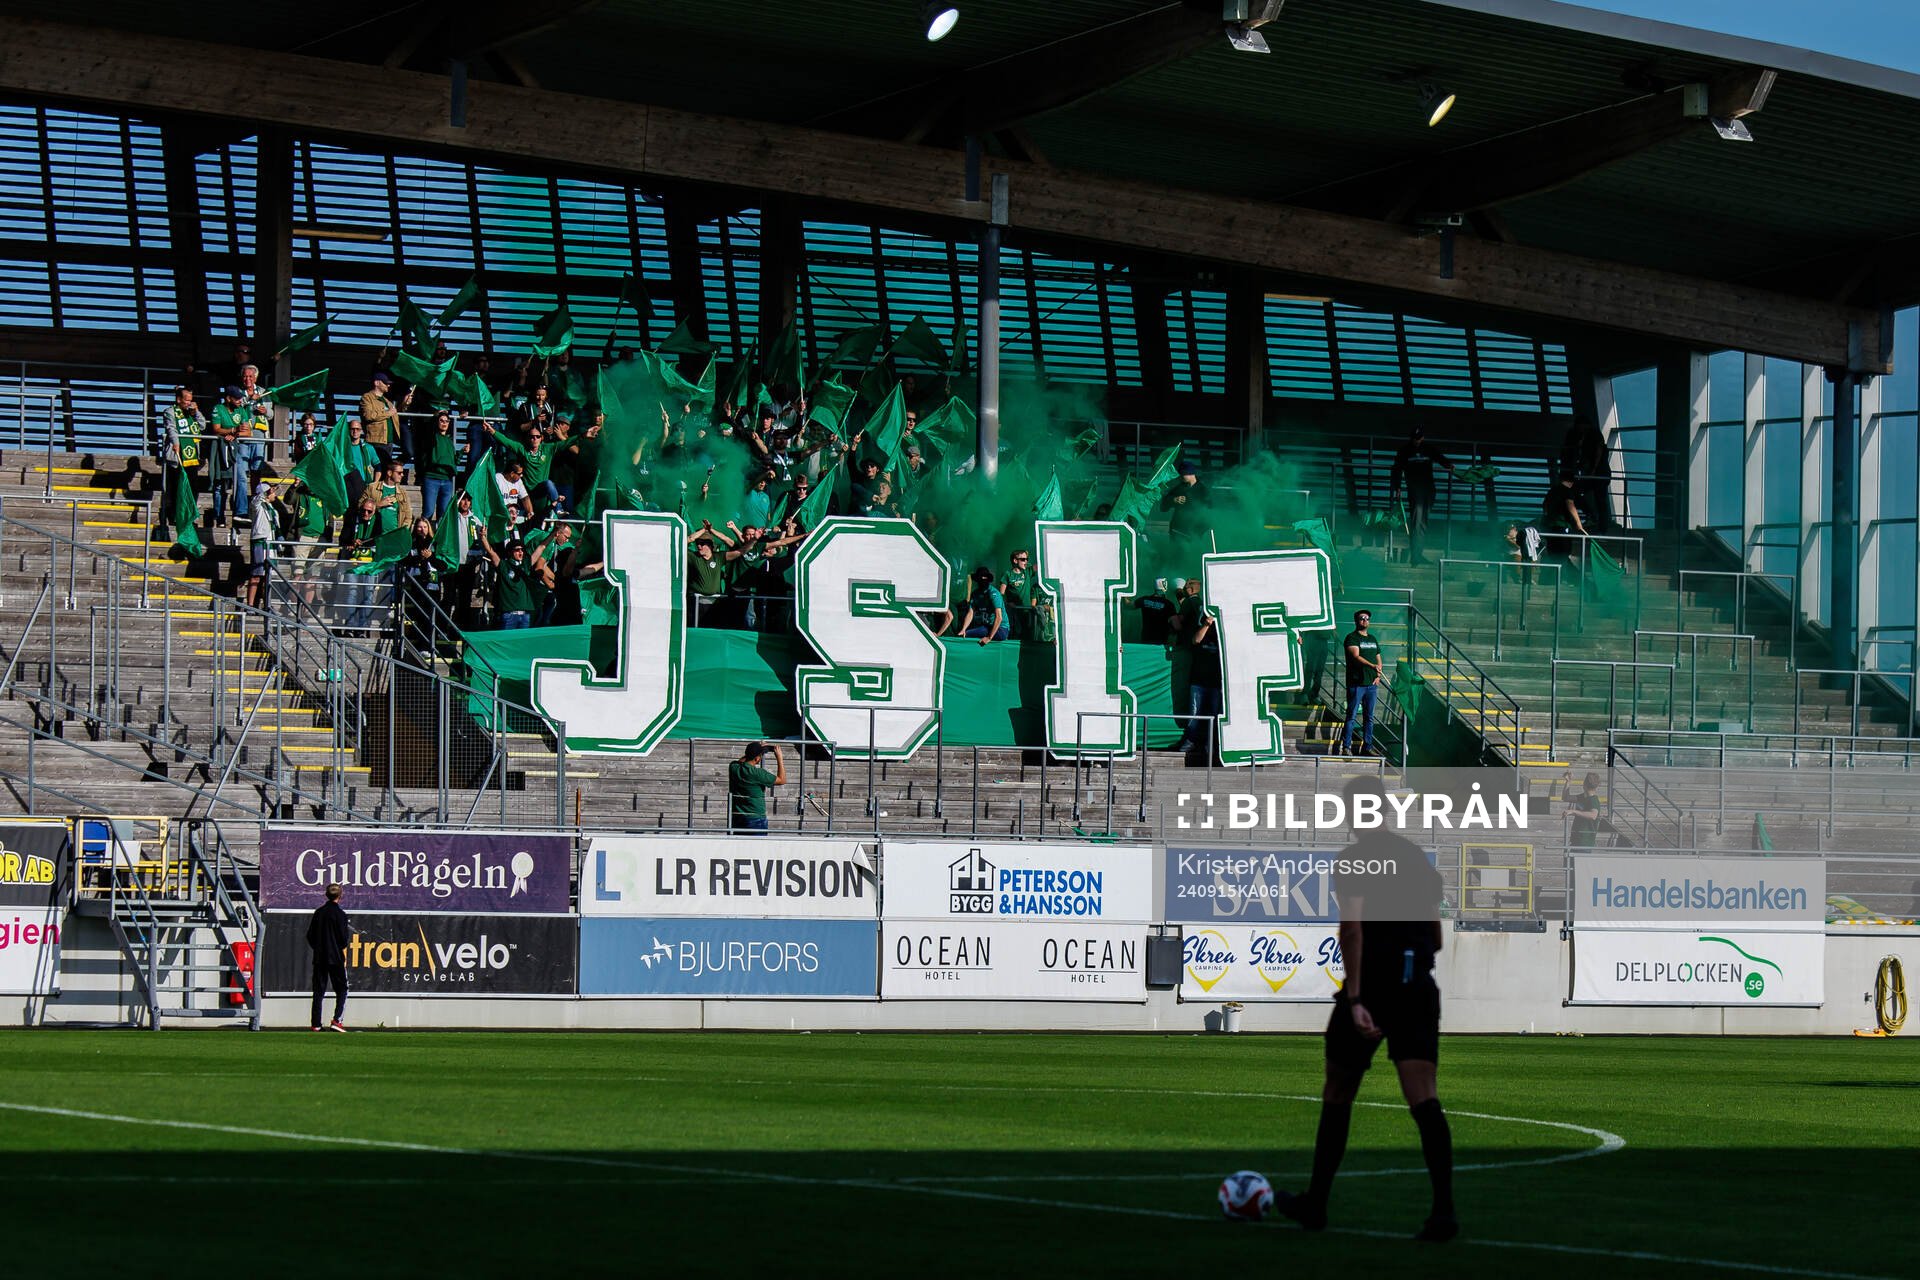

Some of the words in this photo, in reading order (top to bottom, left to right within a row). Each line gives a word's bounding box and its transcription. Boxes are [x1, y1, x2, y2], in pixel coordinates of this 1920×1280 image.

[24, 855, 55, 882] AB
[295, 849, 509, 898] GuldFågeln
[655, 857, 697, 896] LR
[709, 858, 863, 898] REVISION
[1000, 869, 1103, 893] PETERSON
[950, 895, 993, 913] BYGG
[1000, 894, 1102, 915] &HANSSON
[1592, 877, 1807, 910] Handelsbanken
[435, 935, 510, 969] velo
[679, 941, 819, 977] BJURFORS
[896, 935, 991, 967] OCEAN
[1043, 938, 1136, 970] OCEAN
[1183, 935, 1238, 965] Skrea
[1248, 936, 1305, 966] Skrea
[1316, 936, 1343, 967] Sk
[925, 971, 961, 981] HOTEL
[1071, 973, 1106, 984] HOTEL
[1616, 962, 1743, 983] DELPLOCKEN
[1746, 980, 1763, 991] .se
